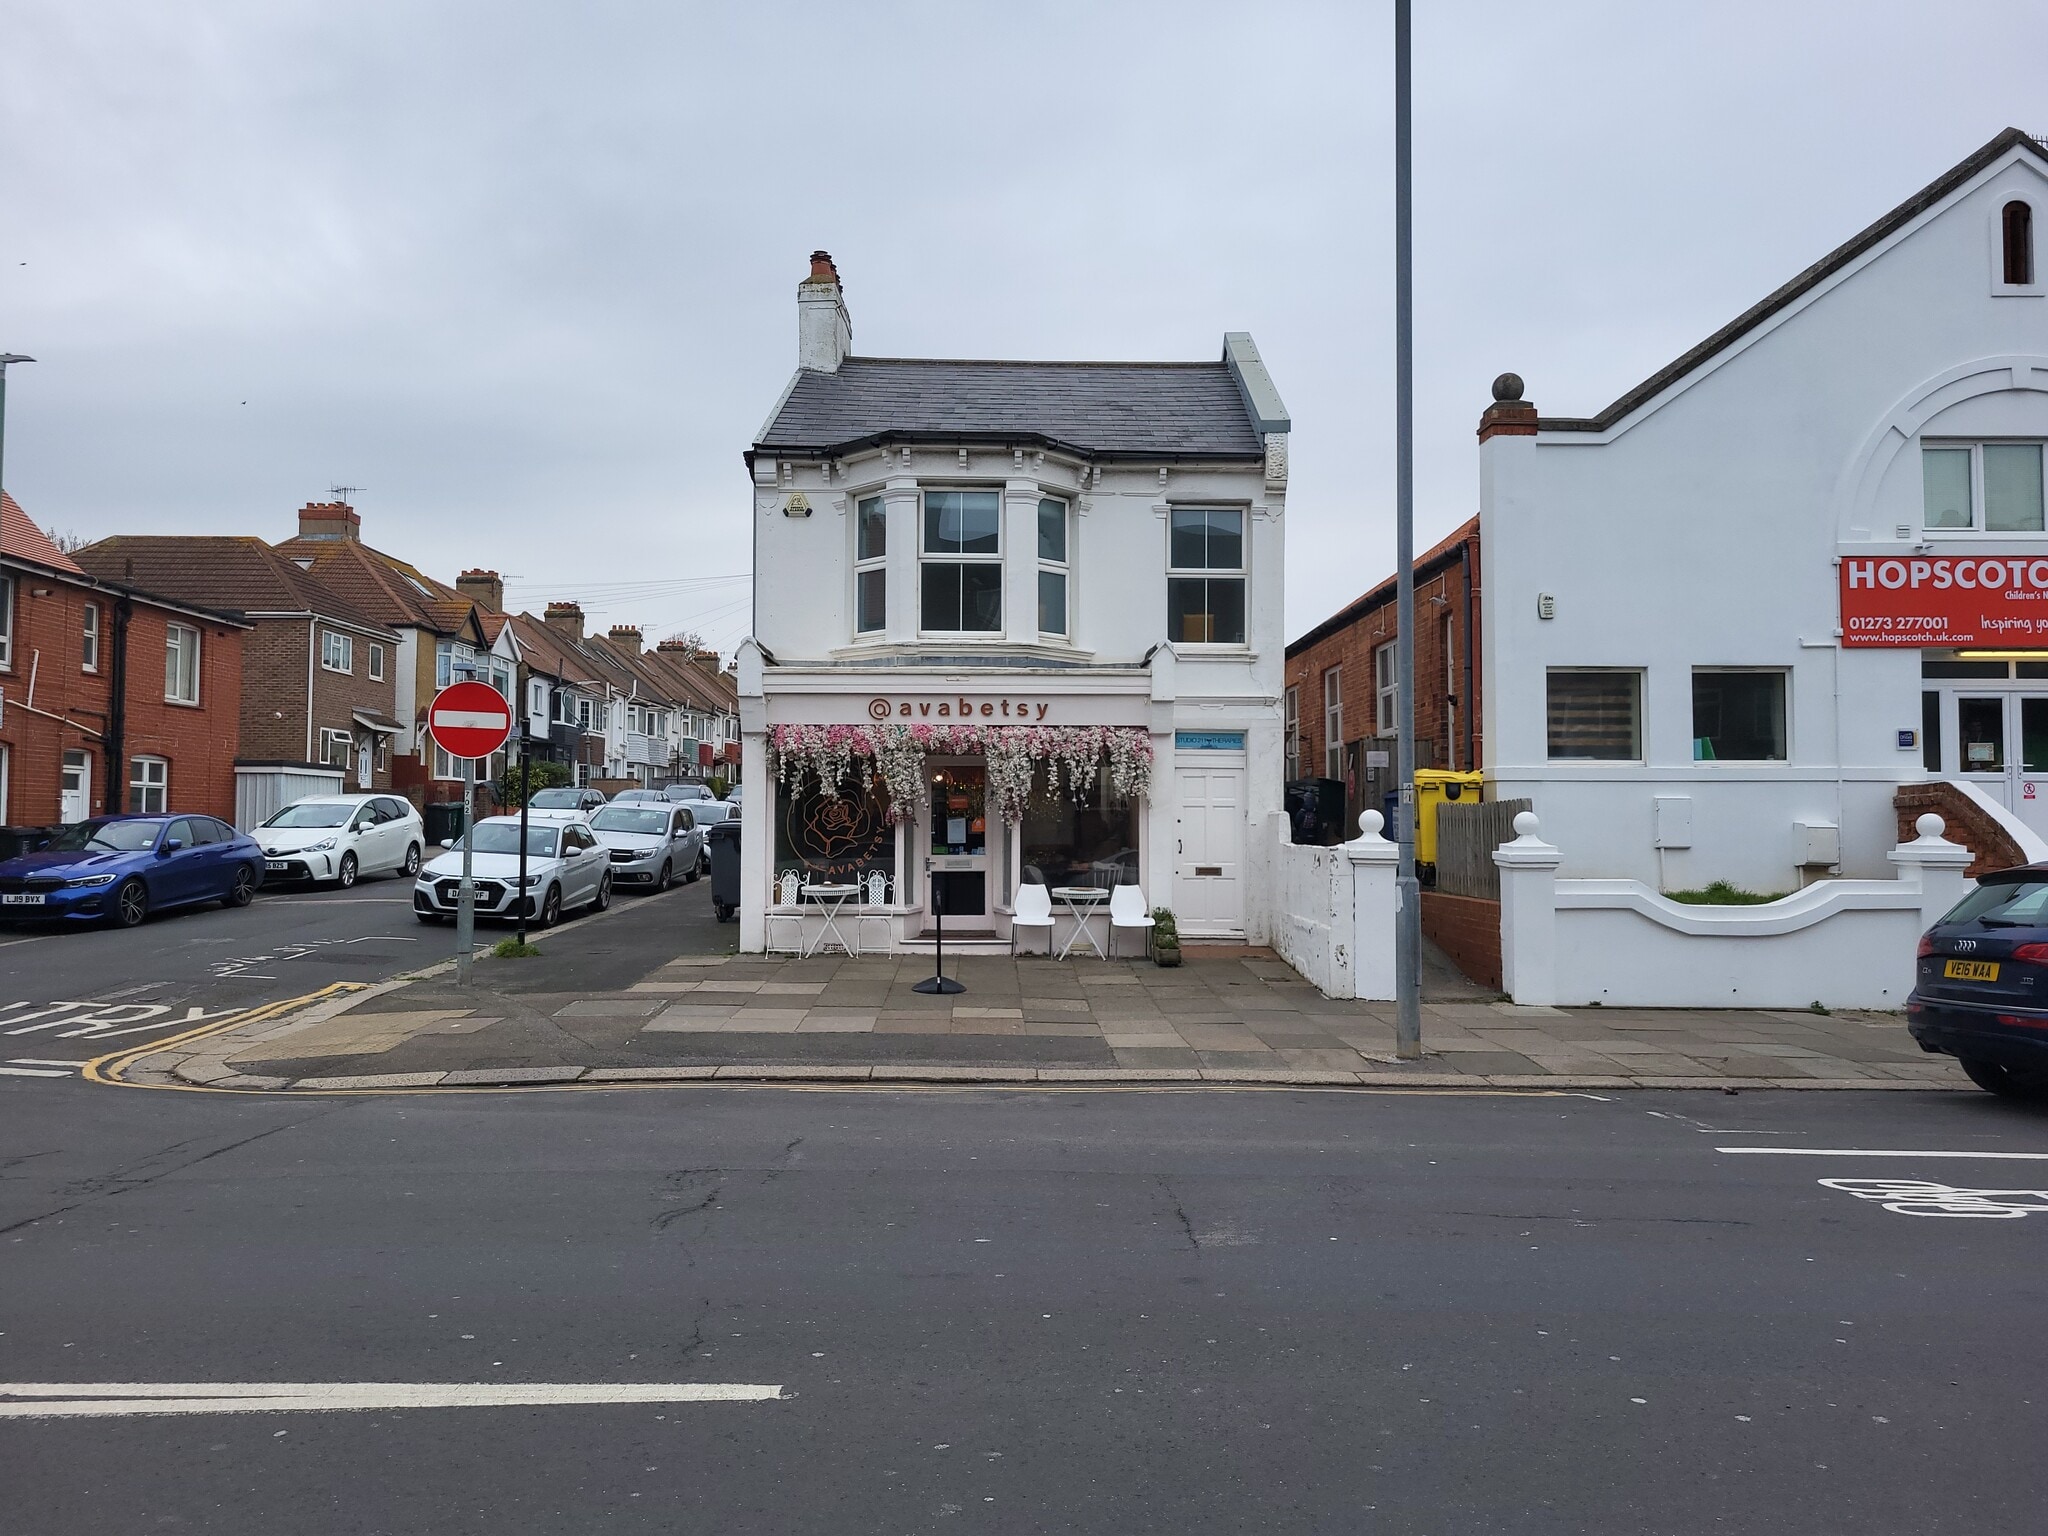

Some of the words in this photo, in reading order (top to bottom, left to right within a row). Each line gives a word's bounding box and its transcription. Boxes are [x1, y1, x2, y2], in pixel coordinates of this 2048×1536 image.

[2005, 590, 2041, 600] Children's
[1849, 617, 1893, 630] 01273
[1896, 617, 1948, 630] 277001
[1981, 614, 2032, 634] Inspiring
[1850, 632, 1974, 644] www.hopscotch.uk.com
[868, 697, 1049, 721] @avabetsy
[828, 825, 886, 875] AVABETSY
[25, 895, 41, 903] BVX
[1951, 961, 1971, 976] VE16
